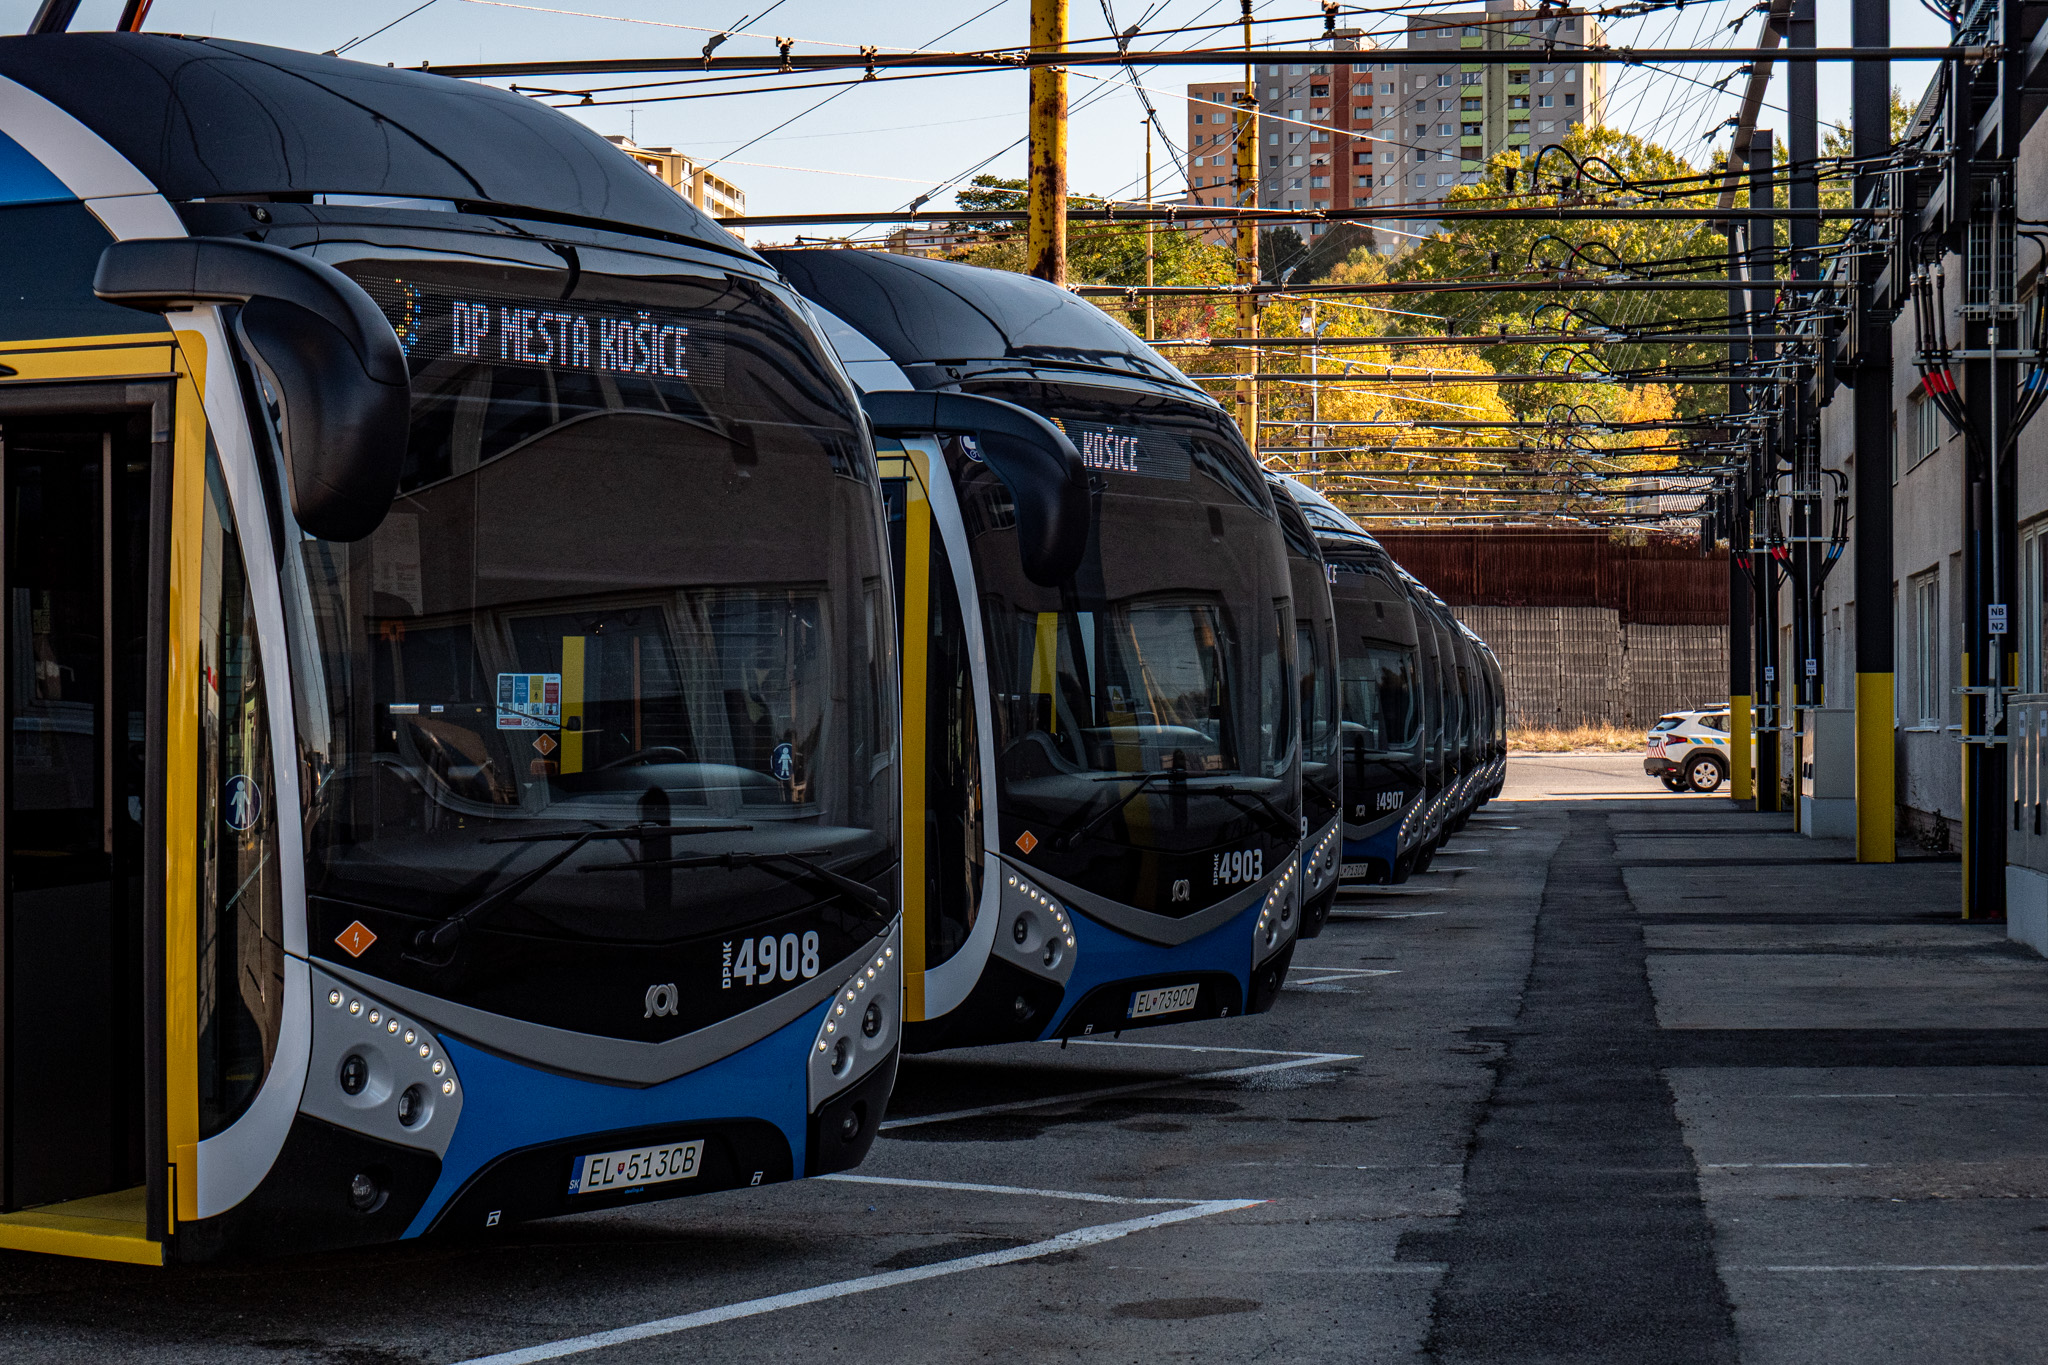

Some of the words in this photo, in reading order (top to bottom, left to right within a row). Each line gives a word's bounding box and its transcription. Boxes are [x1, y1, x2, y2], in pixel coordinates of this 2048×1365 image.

[453, 301, 489, 357] DP
[501, 306, 589, 368] MESTA
[600, 311, 689, 378] KOŠICE
[1083, 426, 1138, 472] KOŠICE
[1991, 607, 2005, 616] NB
[1991, 622, 2005, 631] N2
[1380, 791, 1404, 810] 4907
[1219, 848, 1263, 885] 4903
[722, 940, 733, 989] DPMK
[733, 930, 820, 986] 4908
[1137, 993, 1152, 1013] EL
[1158, 987, 1195, 1010] 739CC
[569, 1179, 580, 1190] SK
[587, 1157, 615, 1187] EL
[626, 1146, 696, 1181] 513CB
